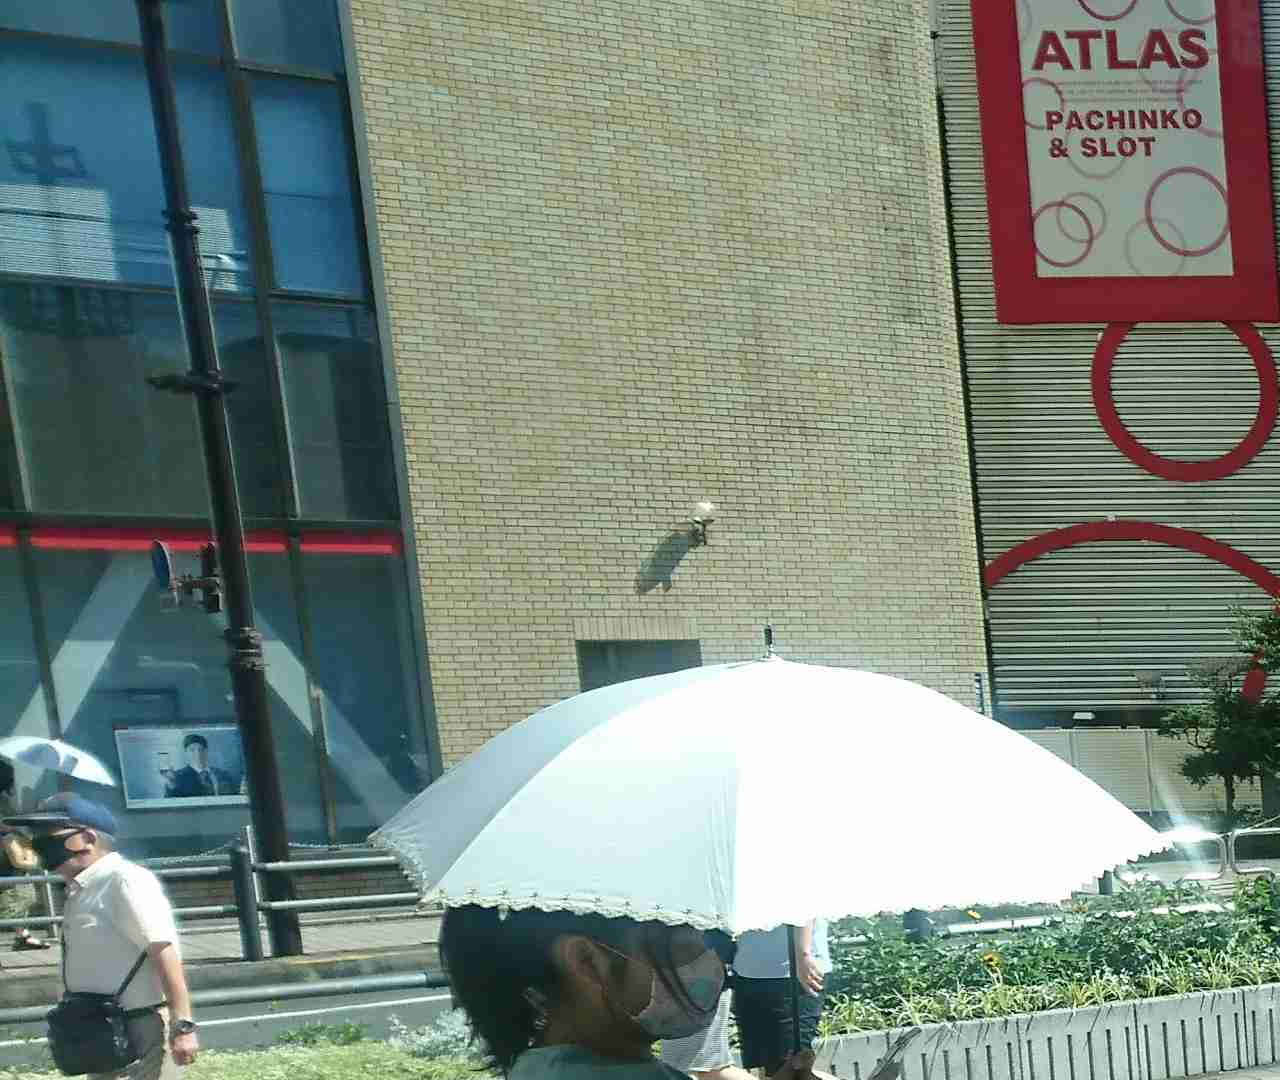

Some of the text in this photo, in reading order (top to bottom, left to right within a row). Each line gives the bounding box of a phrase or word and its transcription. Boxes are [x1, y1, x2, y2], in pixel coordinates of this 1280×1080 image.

[1032, 29, 1209, 71] ATLAS
[1045, 109, 1202, 131] PACHINKO
[1049, 136, 1156, 158] & SLOT
